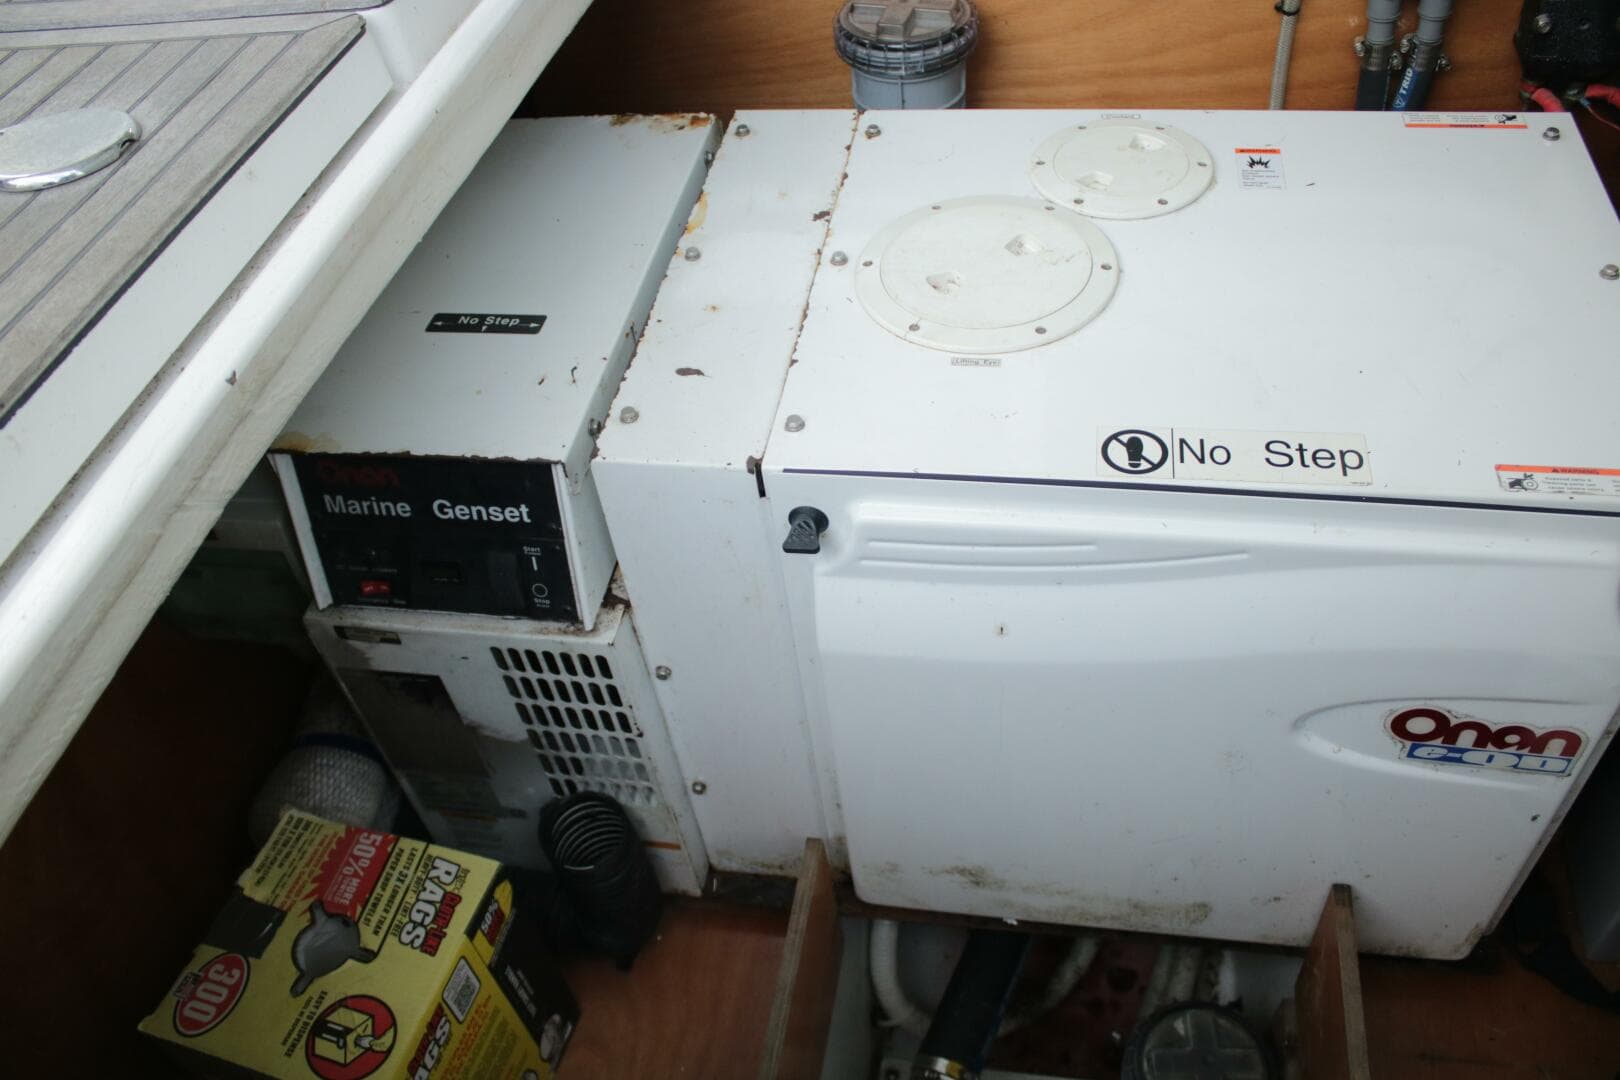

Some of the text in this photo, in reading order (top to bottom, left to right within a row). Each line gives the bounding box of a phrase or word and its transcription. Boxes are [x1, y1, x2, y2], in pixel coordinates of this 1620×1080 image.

[458, 315, 520, 328] No Step
[1177, 438, 1365, 477] No Step
[322, 493, 532, 524] Marine Genset
[522, 545, 541, 554] Start
[533, 597, 551, 605] Stop
[1390, 707, 1582, 758] Onan
[342, 832, 384, 876] 50%
[389, 848, 404, 871] PAPER
[338, 876, 361, 905] MORE
[371, 847, 418, 936] LASTS 3X LONGER THAN
[379, 871, 393, 891] SHOP
[398, 855, 461, 950] RAGS
[181, 961, 242, 1021] 300
[313, 990, 328, 1010] EASY
[306, 1010, 317, 1021] TO
[284, 1021, 311, 1058] DISPENSE
